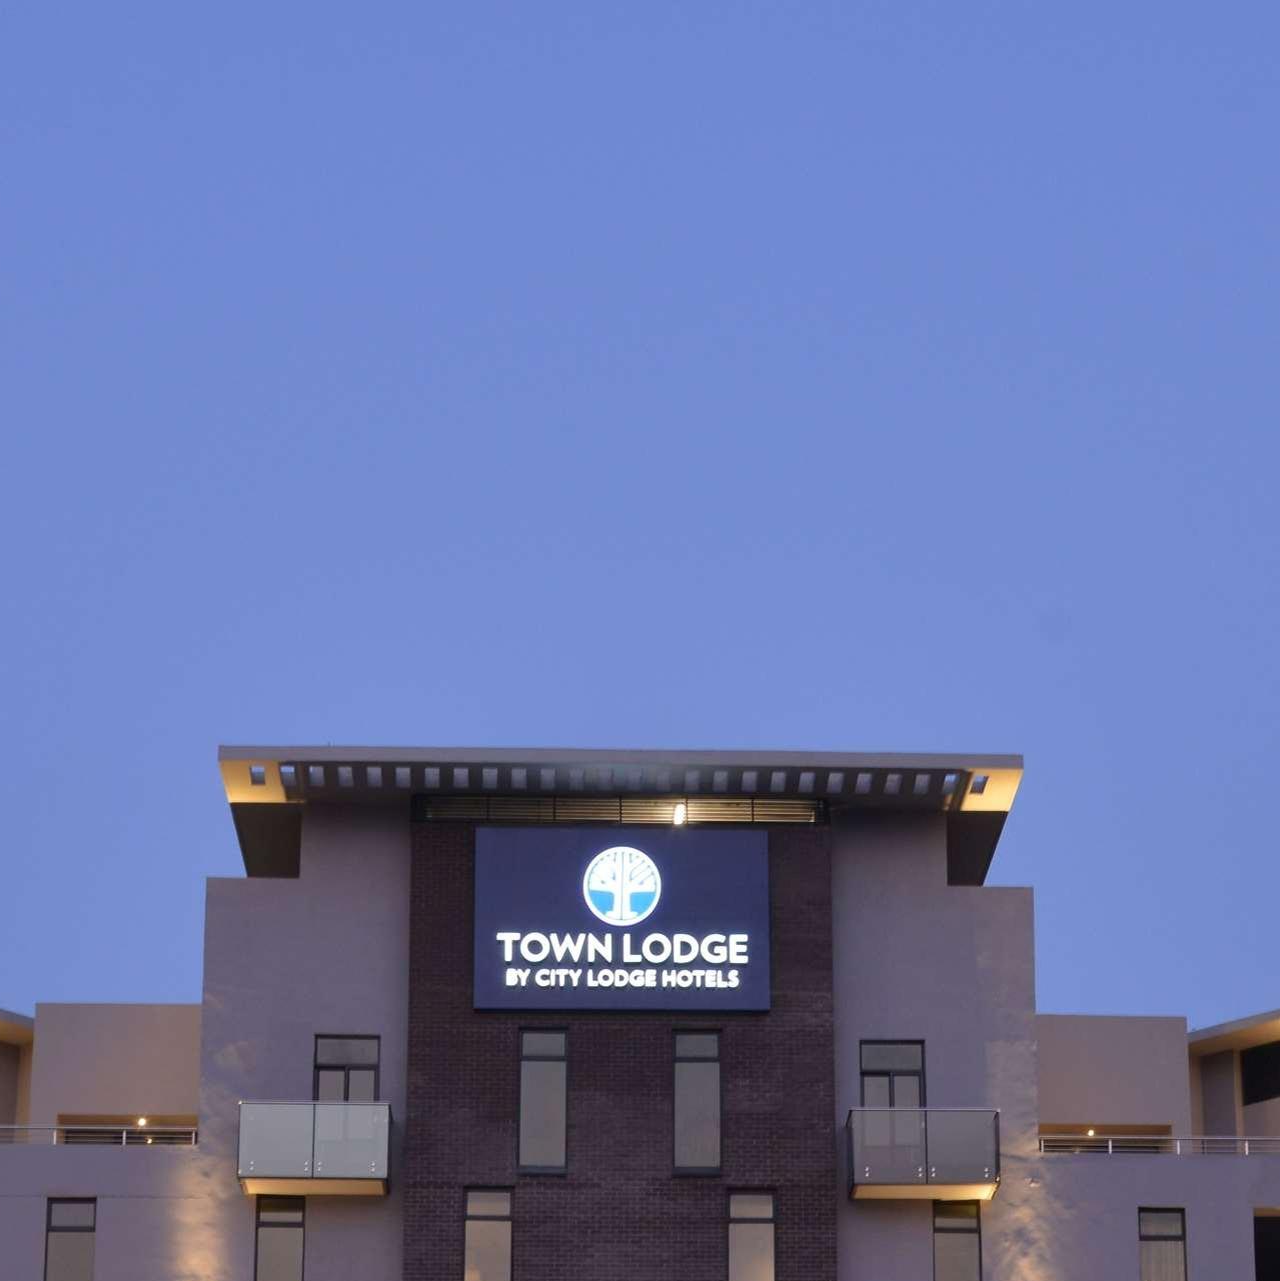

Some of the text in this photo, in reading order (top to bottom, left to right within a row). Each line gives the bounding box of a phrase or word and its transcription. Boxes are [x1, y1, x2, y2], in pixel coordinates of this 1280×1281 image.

[496, 932, 749, 964] TOWN LODGE
[505, 968, 740, 988] BY CITY LODGE HOTELS
